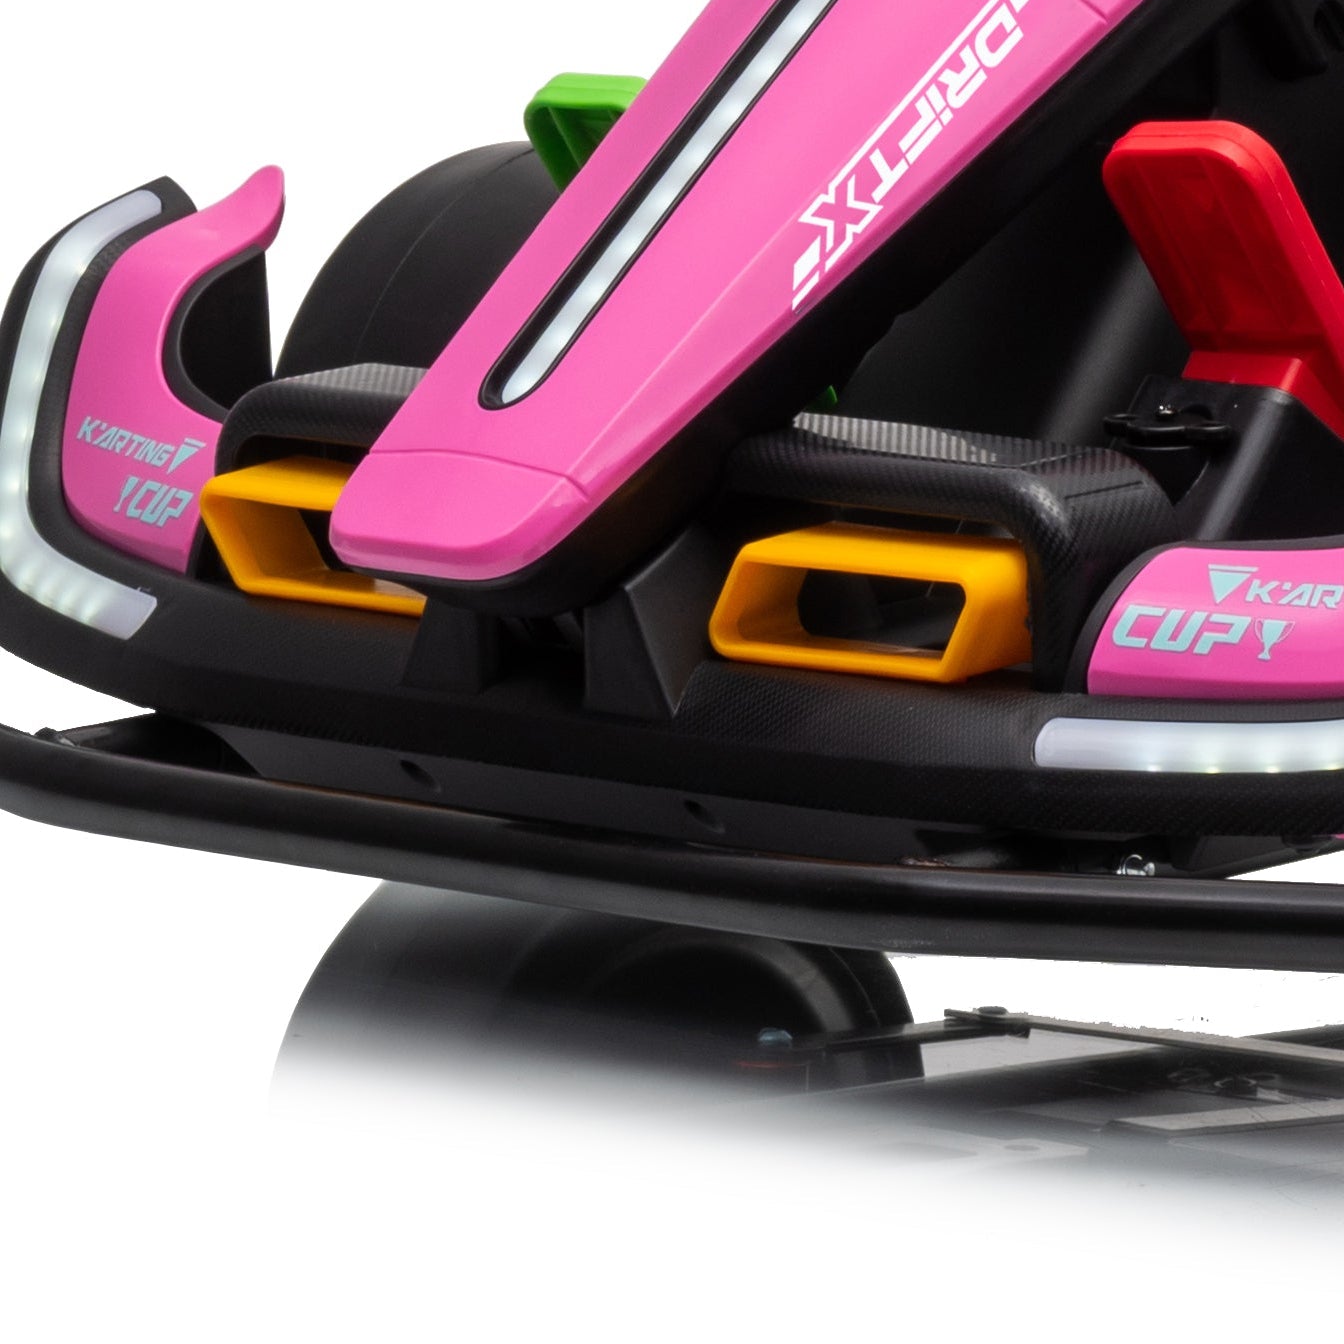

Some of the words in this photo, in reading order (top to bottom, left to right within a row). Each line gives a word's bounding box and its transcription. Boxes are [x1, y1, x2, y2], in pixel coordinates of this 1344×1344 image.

[76, 415, 176, 467] K'ARTING
[125, 479, 194, 528] CUP
[1112, 603, 1254, 656] CUP
